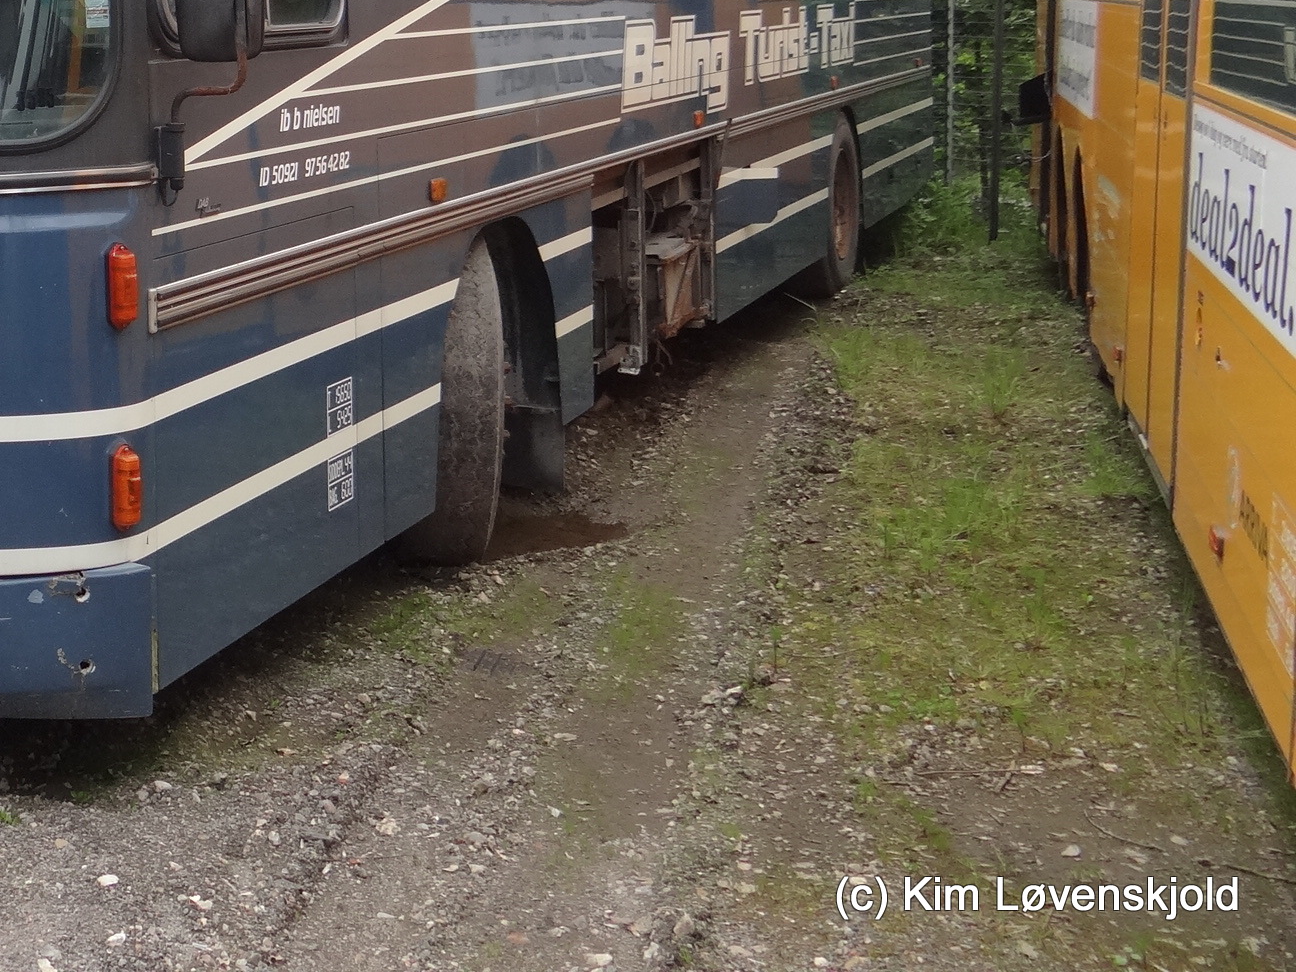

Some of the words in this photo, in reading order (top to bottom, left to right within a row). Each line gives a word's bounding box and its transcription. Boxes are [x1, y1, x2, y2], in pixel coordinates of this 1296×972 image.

[621, 15, 730, 114] Balling
[293, 107, 301, 130] b
[303, 104, 340, 128] nielsen
[259, 167, 270, 187] ID
[272, 162, 299, 185] 50921
